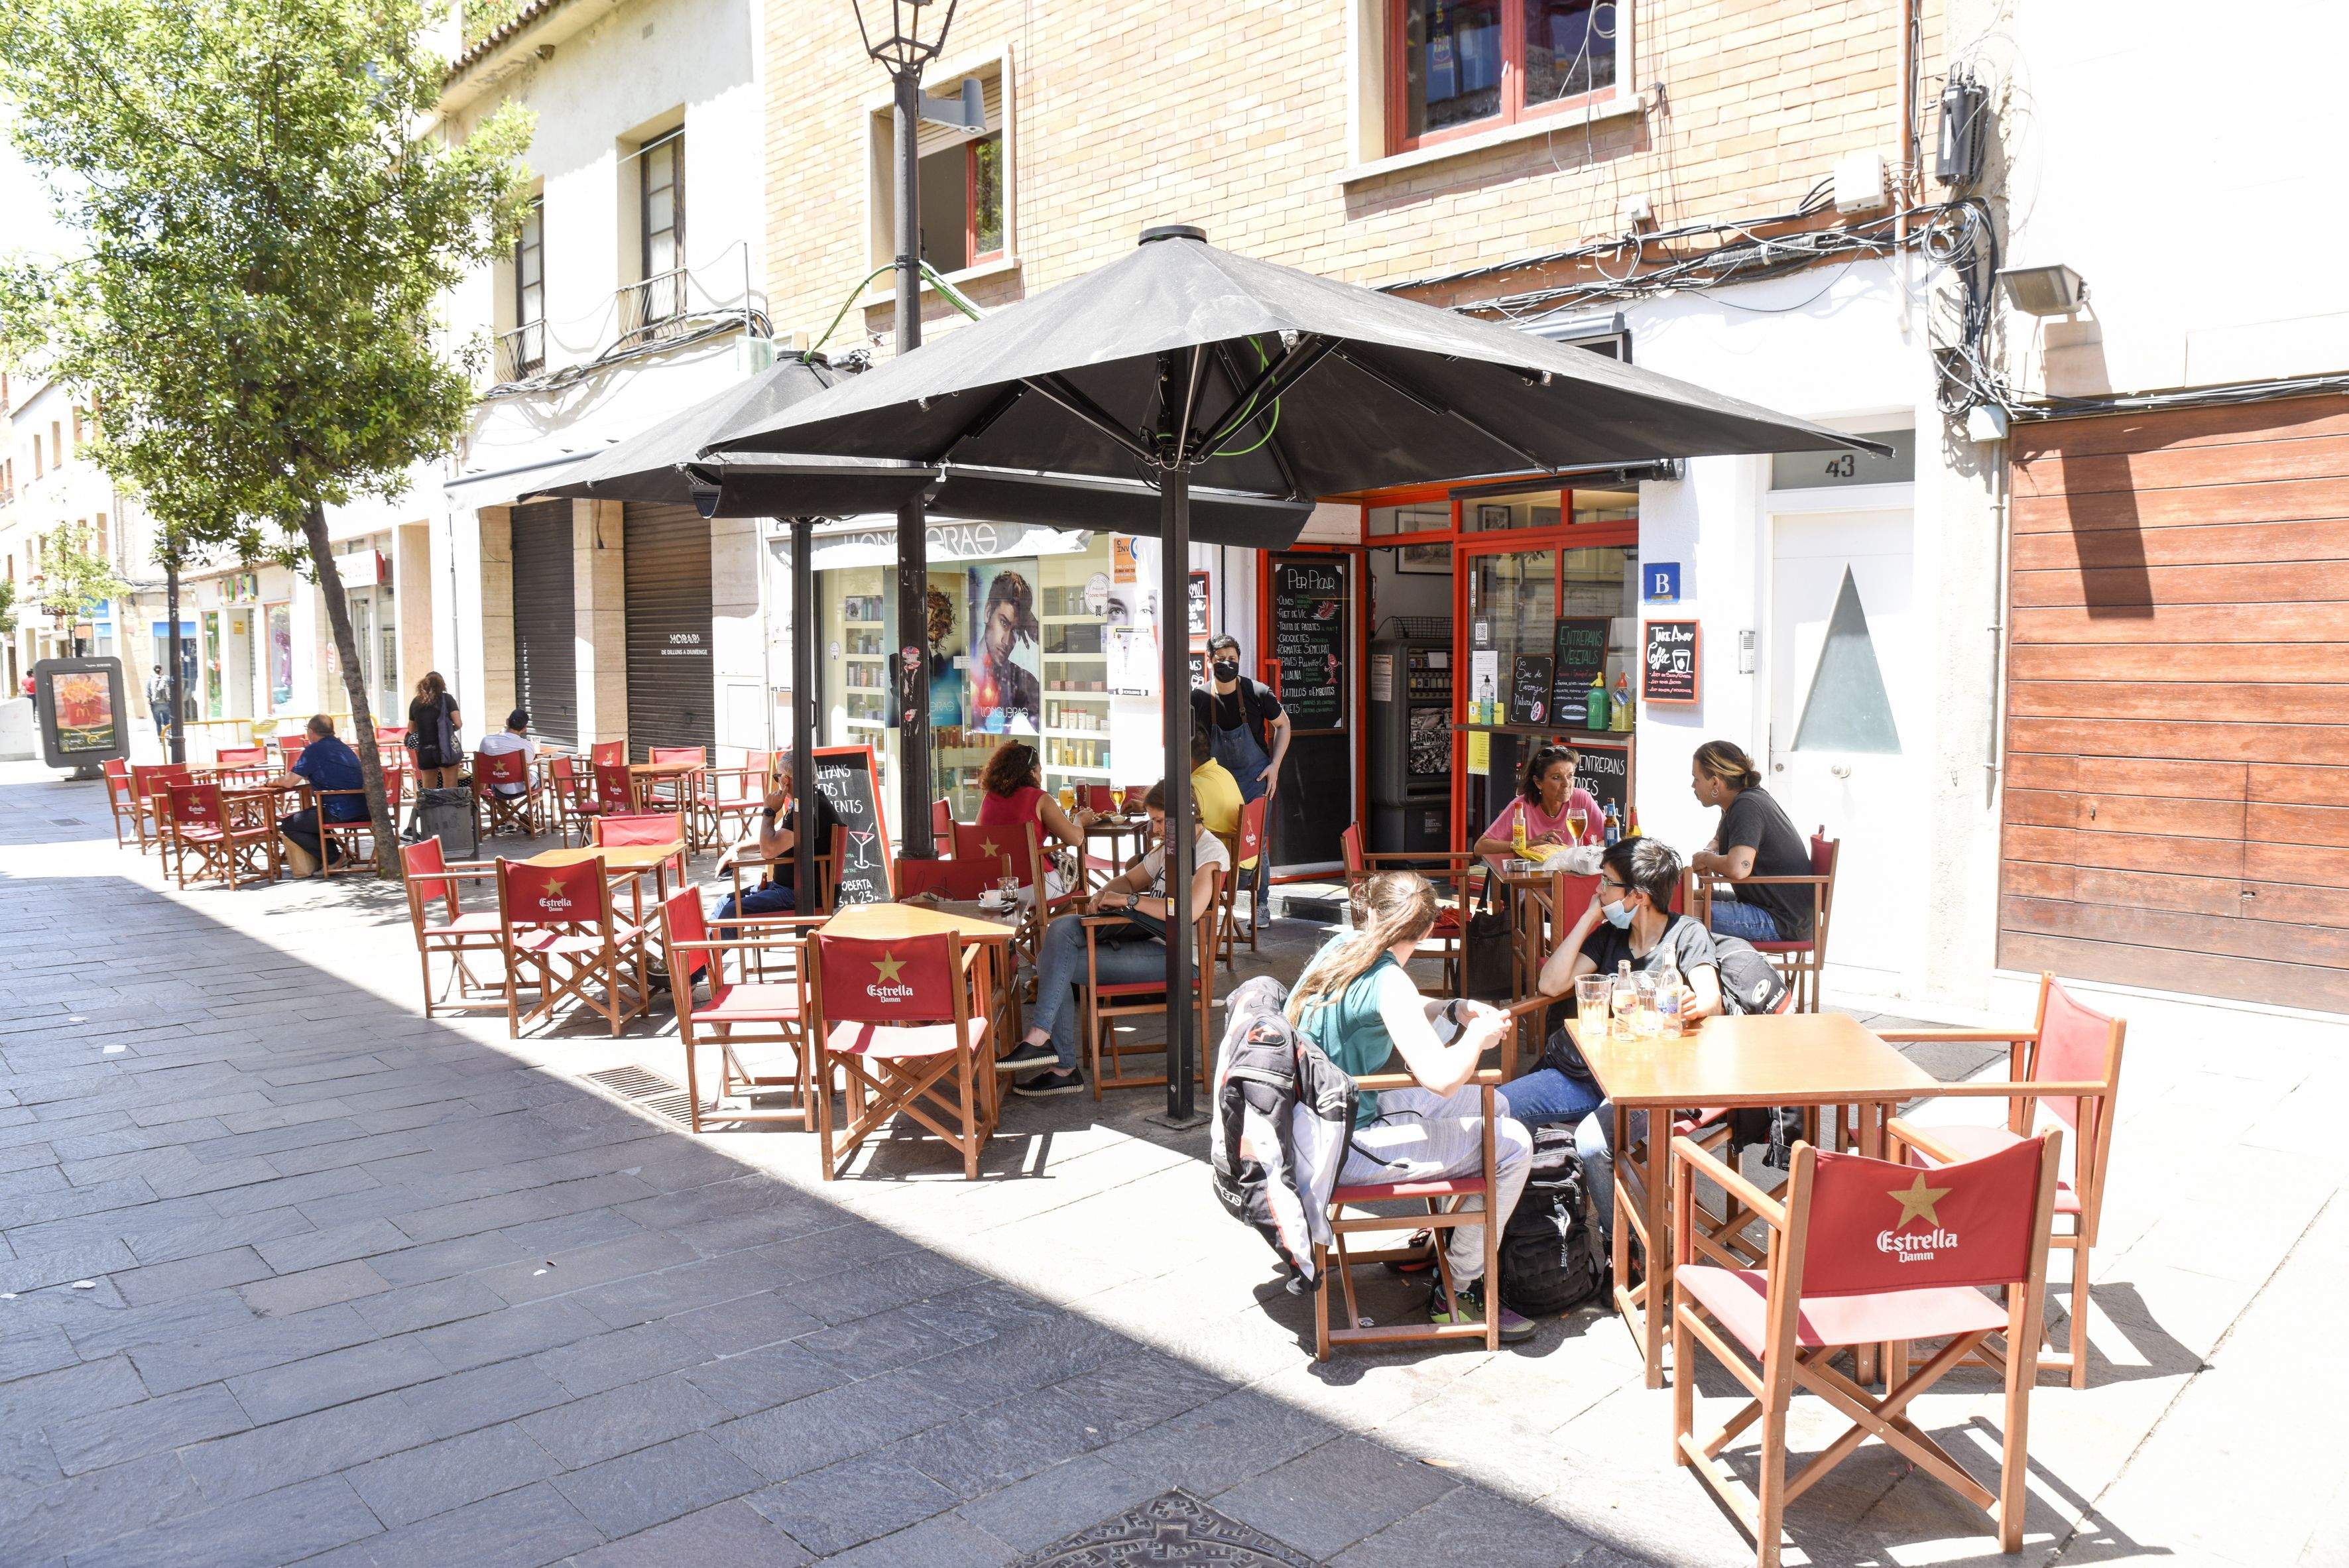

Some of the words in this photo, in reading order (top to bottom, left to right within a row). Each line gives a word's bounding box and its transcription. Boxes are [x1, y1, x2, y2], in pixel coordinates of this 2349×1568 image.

[1825, 455, 1854, 477] 43
[1288, 569, 1307, 589] PER
[1309, 570, 1335, 589] PICAR
[1654, 573, 1670, 594] B
[1278, 595, 1294, 605] OLIVES
[1278, 608, 1290, 619] FUET
[1278, 621, 1294, 631] TRUITA
[1301, 623, 1321, 631] PATATES
[670, 634, 700, 644] HORARI
[1278, 634, 1310, 642] CROQUETES
[1560, 626, 1604, 647] ENTREPANS
[1651, 627, 1671, 642] TAKE
[1671, 625, 1694, 642] AWAY
[1278, 644, 1302, 654] FORMATGE
[1303, 643, 1331, 654] SEMICURAT
[1563, 646, 1599, 664] VEGETALS
[1280, 686, 1307, 697] PLATILLOS
[1416, 733, 1432, 743] BAR
[1579, 754, 1625, 776] ENTREPANS
[841, 878, 873, 891] OBERTA
[539, 897, 572, 908] Estrella
[850, 895, 856, 904] A
[867, 984, 914, 997] Estrella
[1876, 1228, 1958, 1253] Estrella
[1899, 1251, 1934, 1263] Damm
